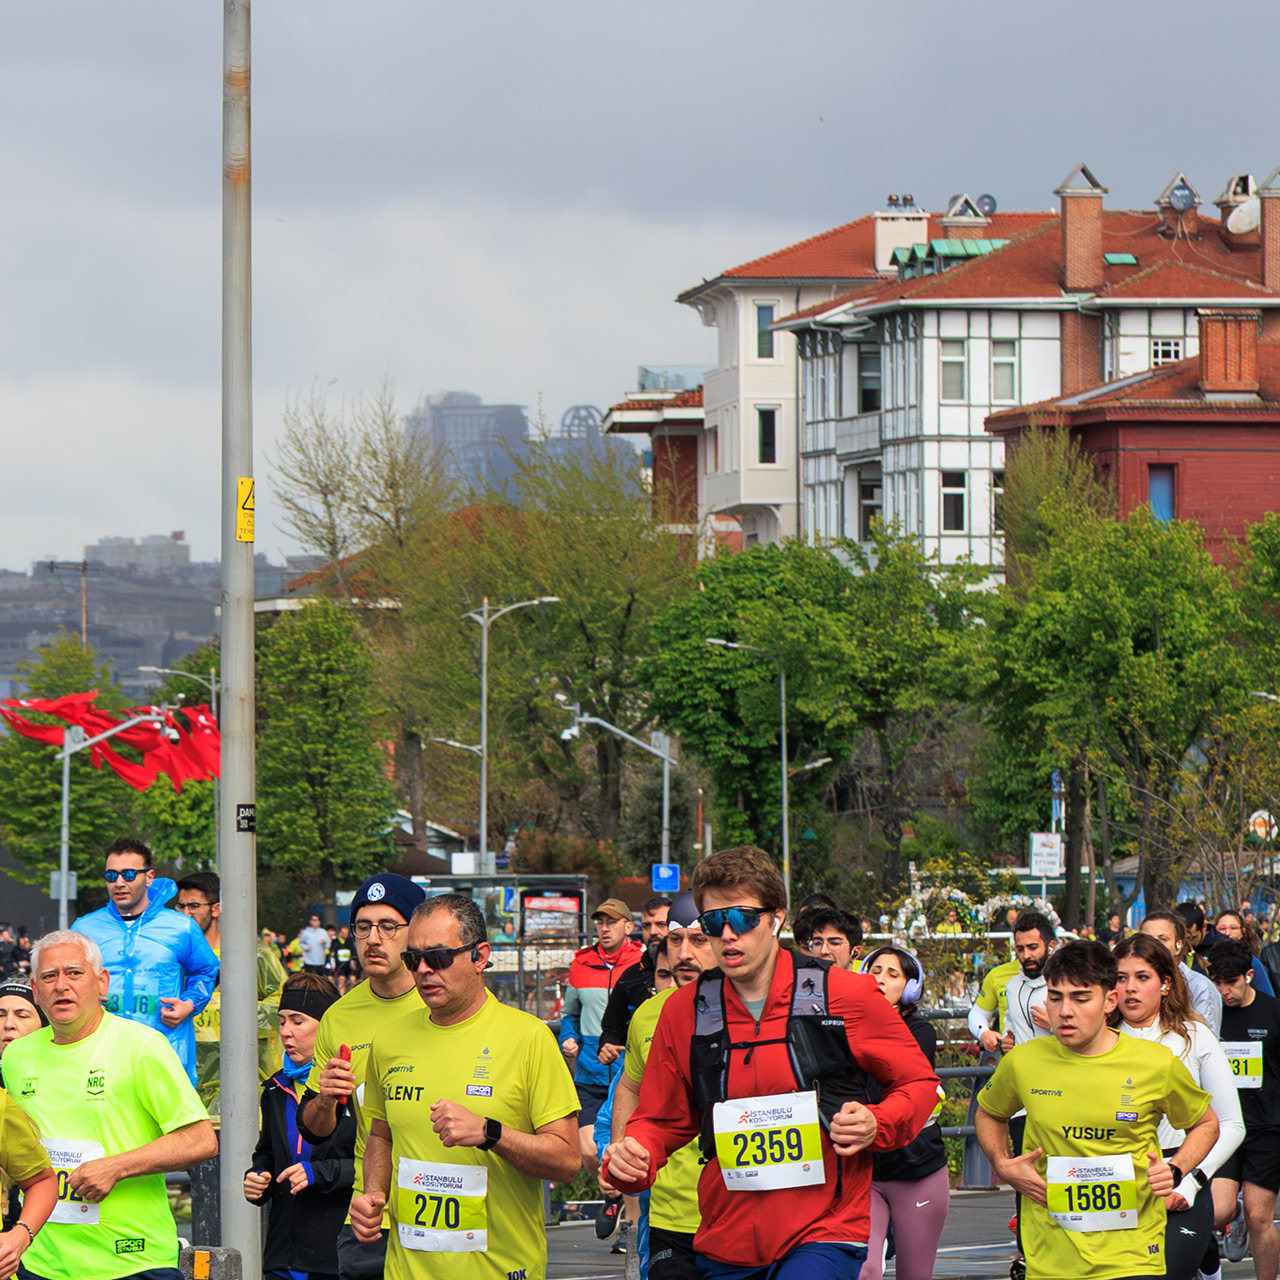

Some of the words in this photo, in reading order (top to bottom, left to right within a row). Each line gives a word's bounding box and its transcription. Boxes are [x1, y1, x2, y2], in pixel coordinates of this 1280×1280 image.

[1228, 1058, 1248, 1076] 31
[86, 1076, 105, 1088] NRC
[1030, 1088, 1062, 1096] SPORTIVE
[750, 1107, 792, 1118] İSTANBULU
[1062, 1126, 1116, 1140] YUSUF
[733, 1128, 803, 1167] 2359
[424, 1174, 463, 1183] İSTANBULU
[1064, 1184, 1122, 1212] 1586
[414, 1194, 460, 1228] 270
[1148, 1244, 1160, 1254] 10K
